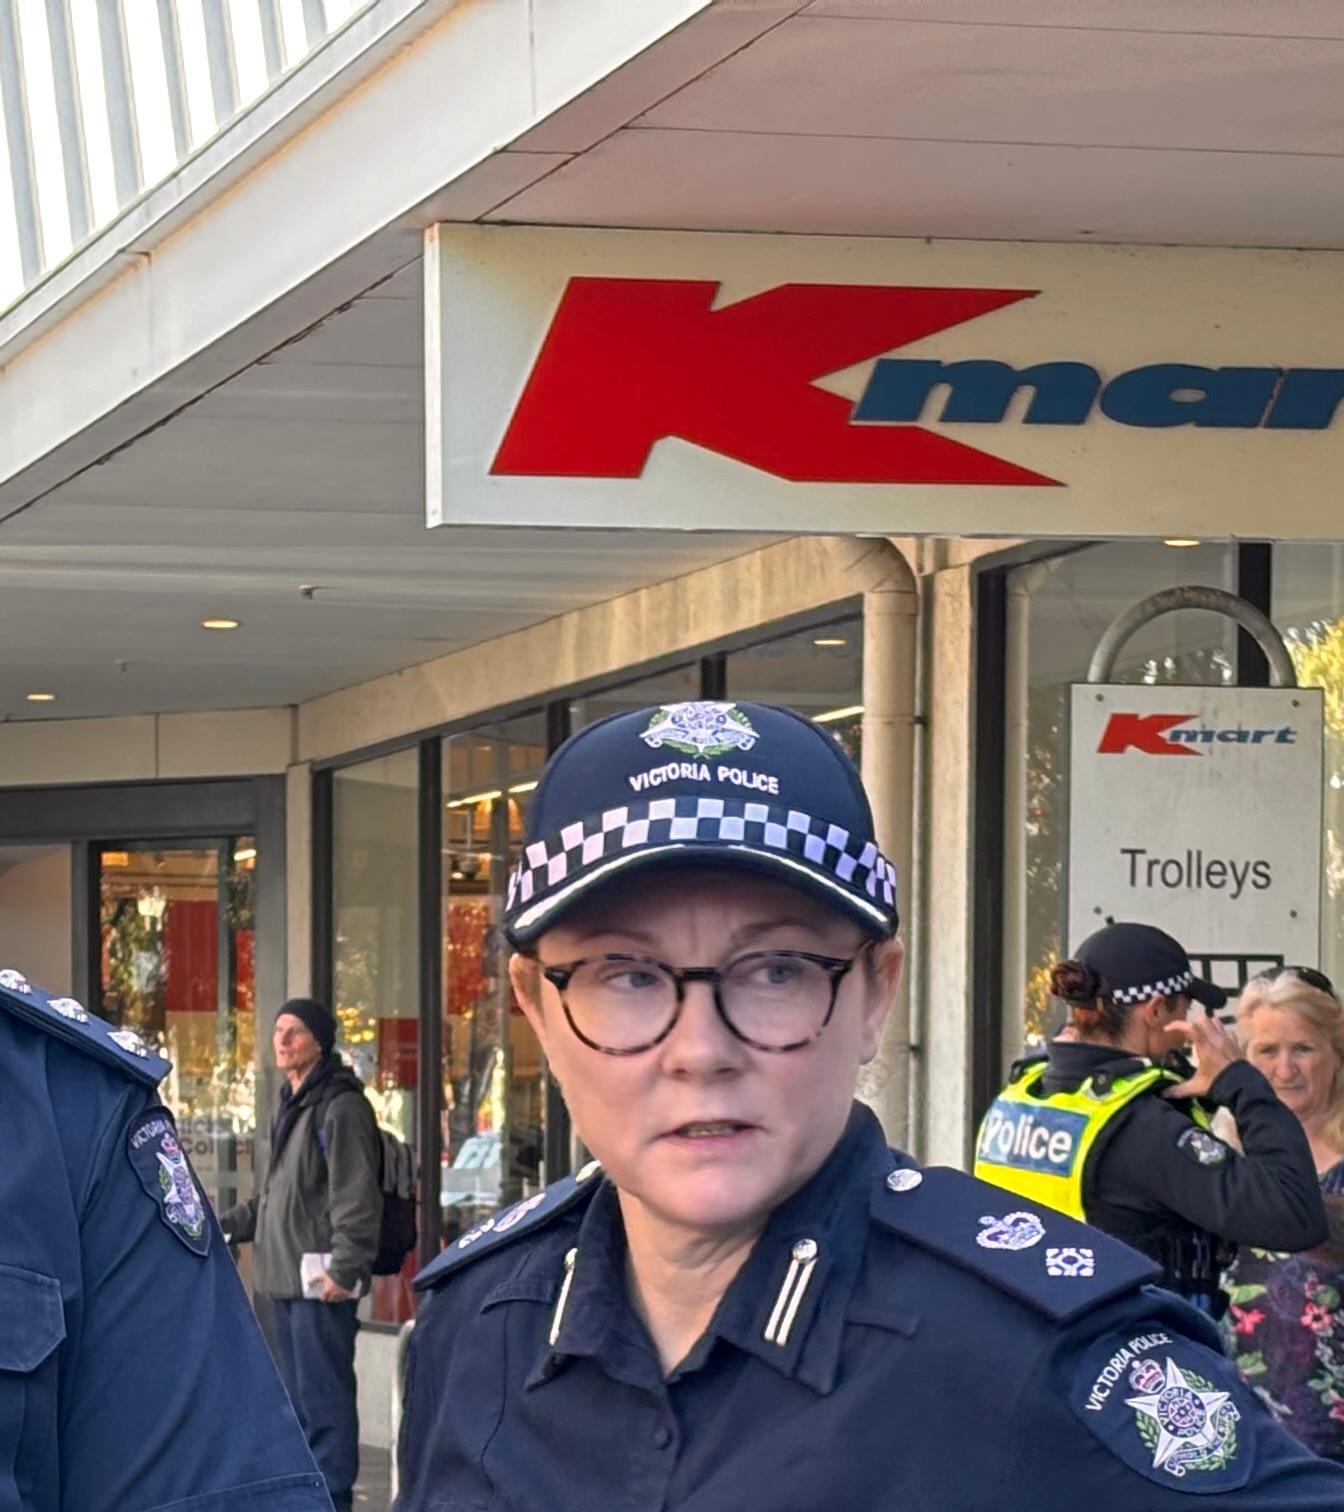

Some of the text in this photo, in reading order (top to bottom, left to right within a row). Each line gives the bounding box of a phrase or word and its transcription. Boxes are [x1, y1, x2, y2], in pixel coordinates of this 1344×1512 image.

[1097, 712, 1299, 757] Kmart
[629, 762, 780, 795] VICTORIA POLICE
[1119, 847, 1273, 899] Trolleys
[130, 1119, 167, 1149] VICTORIA
[981, 1109, 1072, 1164] Police
[1085, 1332, 1174, 1411] VICTORIA POLICE
